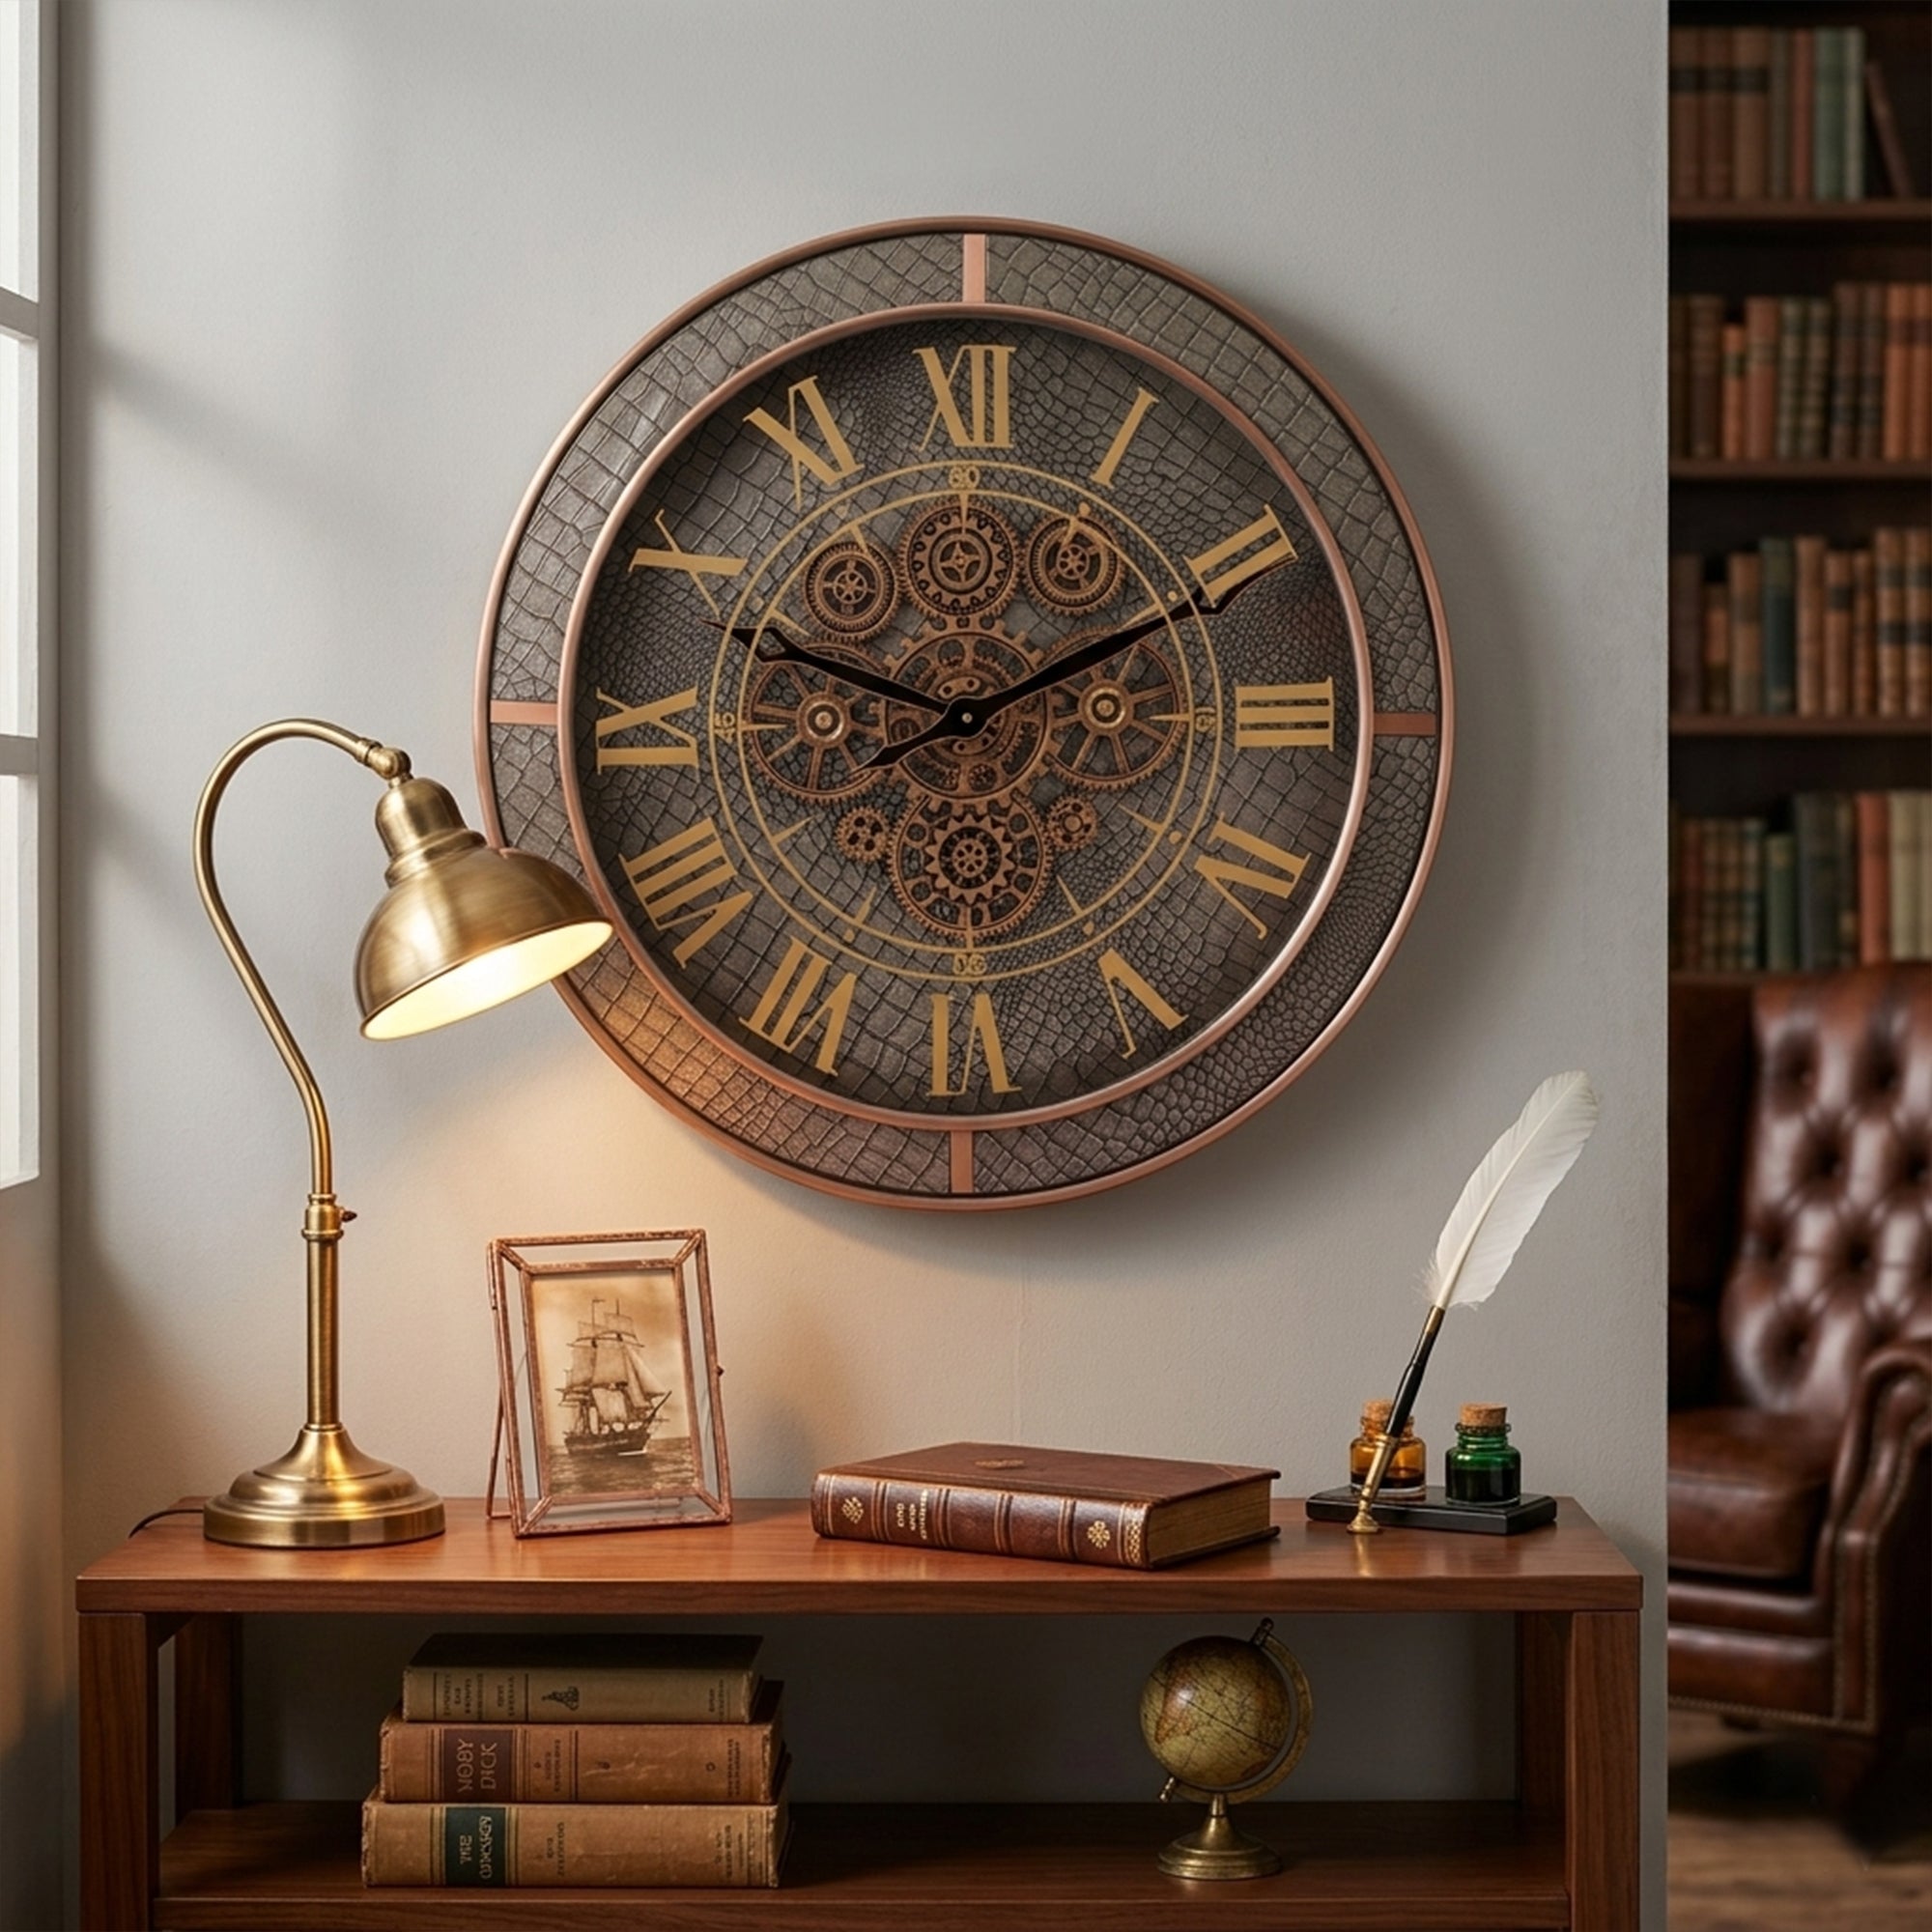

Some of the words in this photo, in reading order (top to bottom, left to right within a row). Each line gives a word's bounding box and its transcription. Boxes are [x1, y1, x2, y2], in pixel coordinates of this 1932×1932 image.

[744, 375, 864, 509] XI
[914, 344, 1015, 451] XII
[1091, 388, 1156, 488] I
[630, 509, 748, 616] X
[1184, 504, 1297, 606] II
[595, 685, 700, 773] IX
[1234, 677, 1335, 751] III
[619, 815, 754, 967] VIII
[1193, 812, 1310, 940] IV
[739, 936, 859, 1075] VII
[928, 991, 1021, 1097] VI
[1096, 947, 1186, 1059] V
[480, 1743, 497, 1790] DICK
